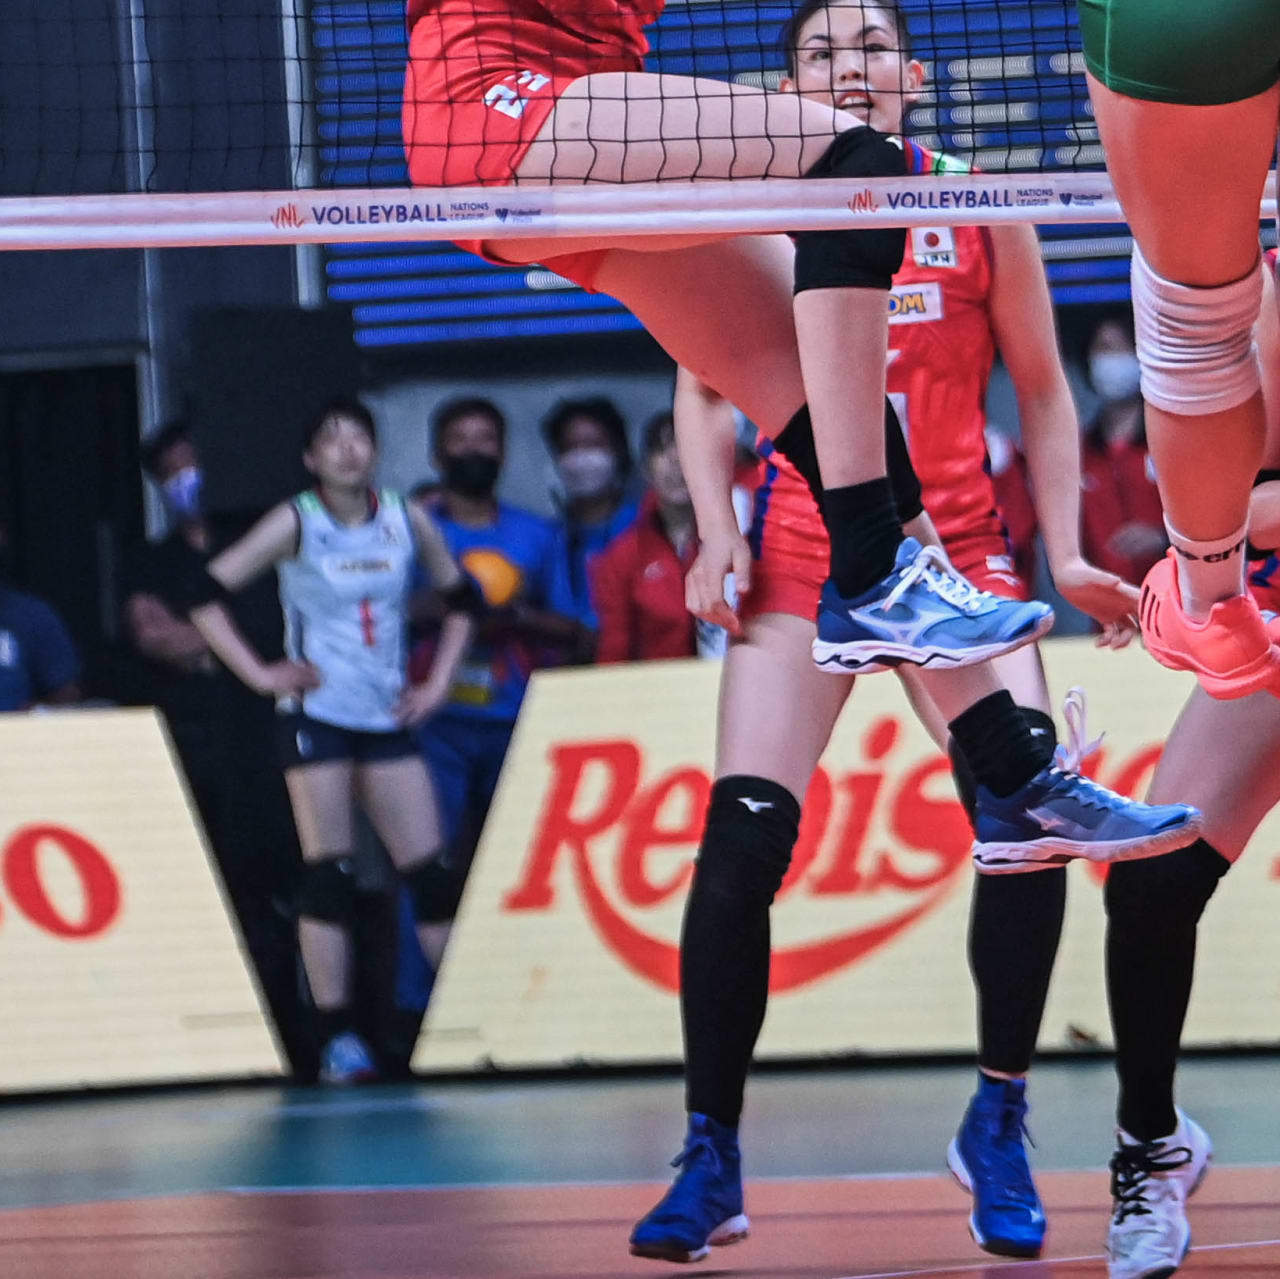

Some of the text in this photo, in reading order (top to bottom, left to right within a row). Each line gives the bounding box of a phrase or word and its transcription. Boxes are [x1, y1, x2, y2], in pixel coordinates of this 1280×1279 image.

[887, 188, 1054, 210] VOLLEYBALL NATIONS
[311, 202, 490, 225] VOLLEYBALL NATIONS
[920, 254, 950, 266] JPN
